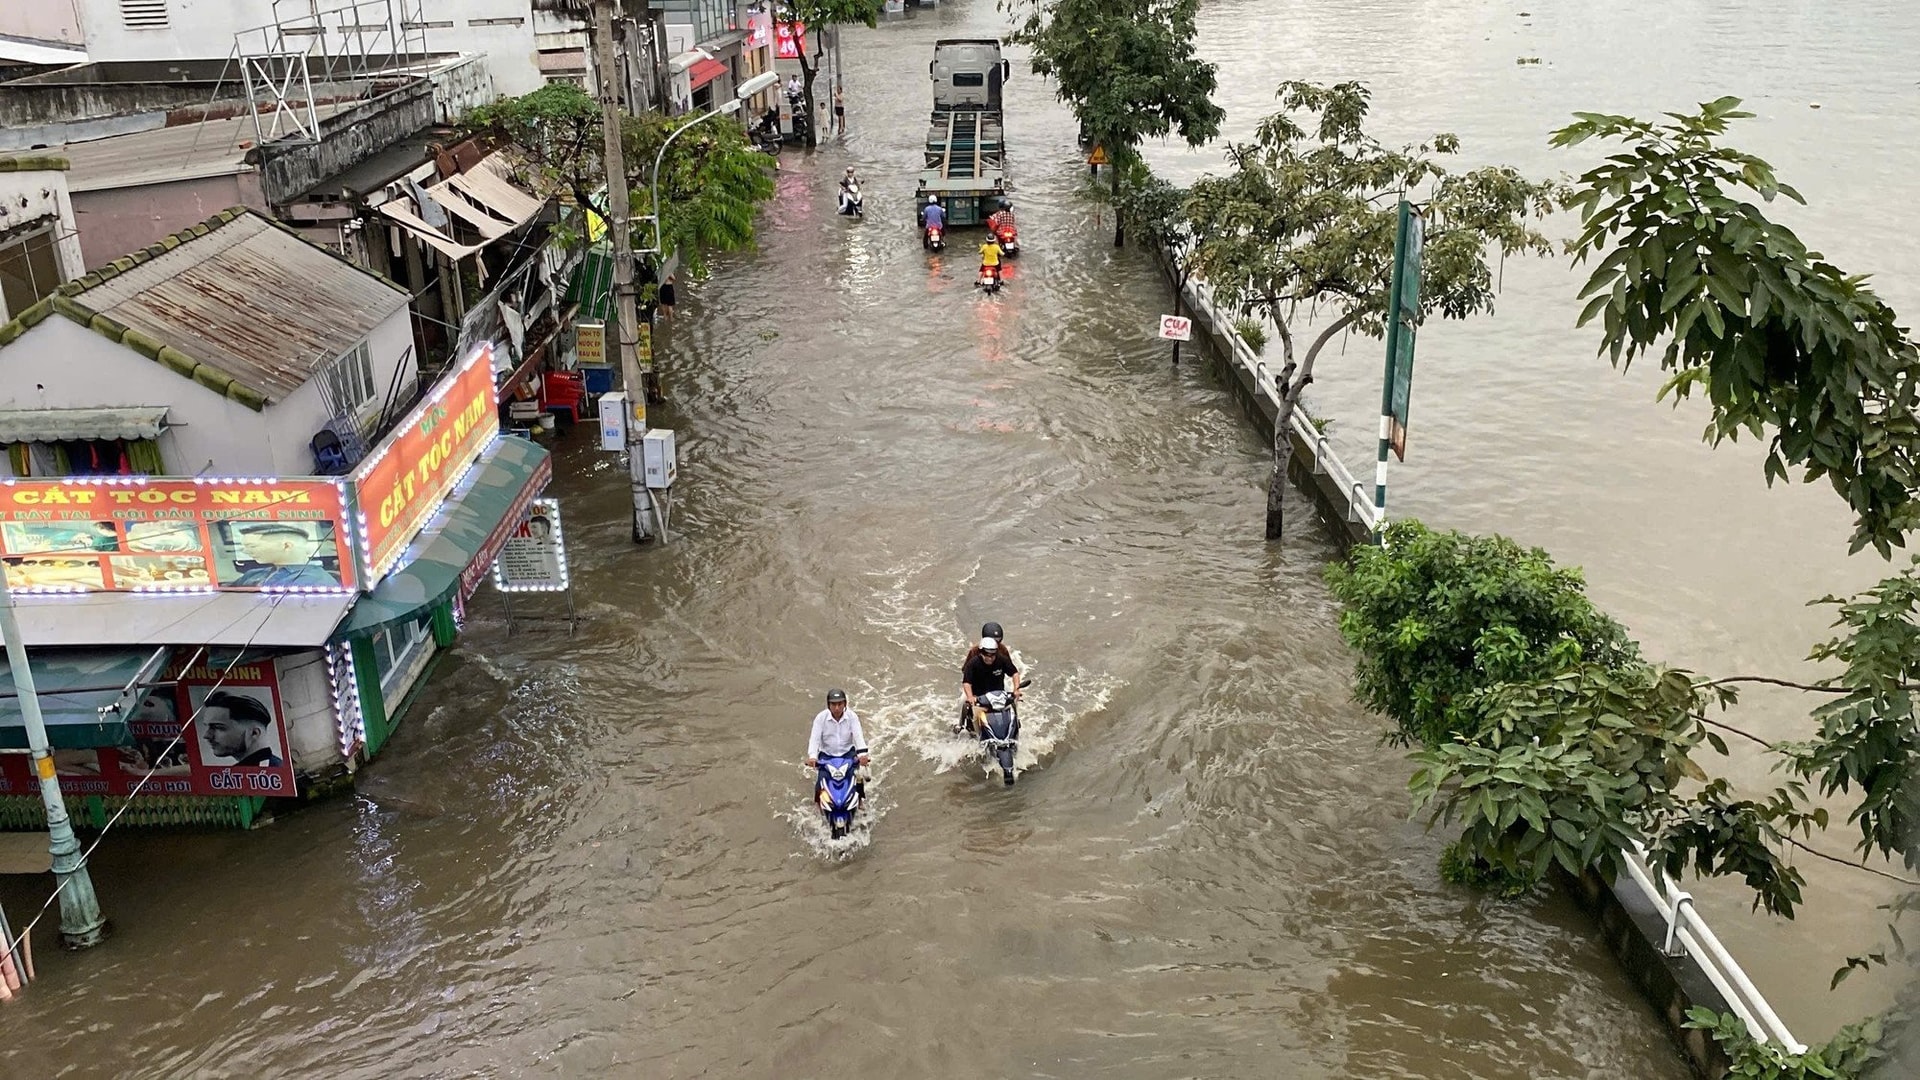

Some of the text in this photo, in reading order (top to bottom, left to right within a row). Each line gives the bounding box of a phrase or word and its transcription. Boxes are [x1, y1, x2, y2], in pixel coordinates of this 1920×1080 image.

[380, 472, 417, 528] CẮT
[417, 436, 453, 483] TÓC
[453, 389, 487, 446] NAM
[13, 485, 311, 504] CẮT TÓC NAM
[277, 510, 325, 519] SINH
[224, 667, 262, 680] SINH
[210, 768, 283, 790] CẮT TÓC
